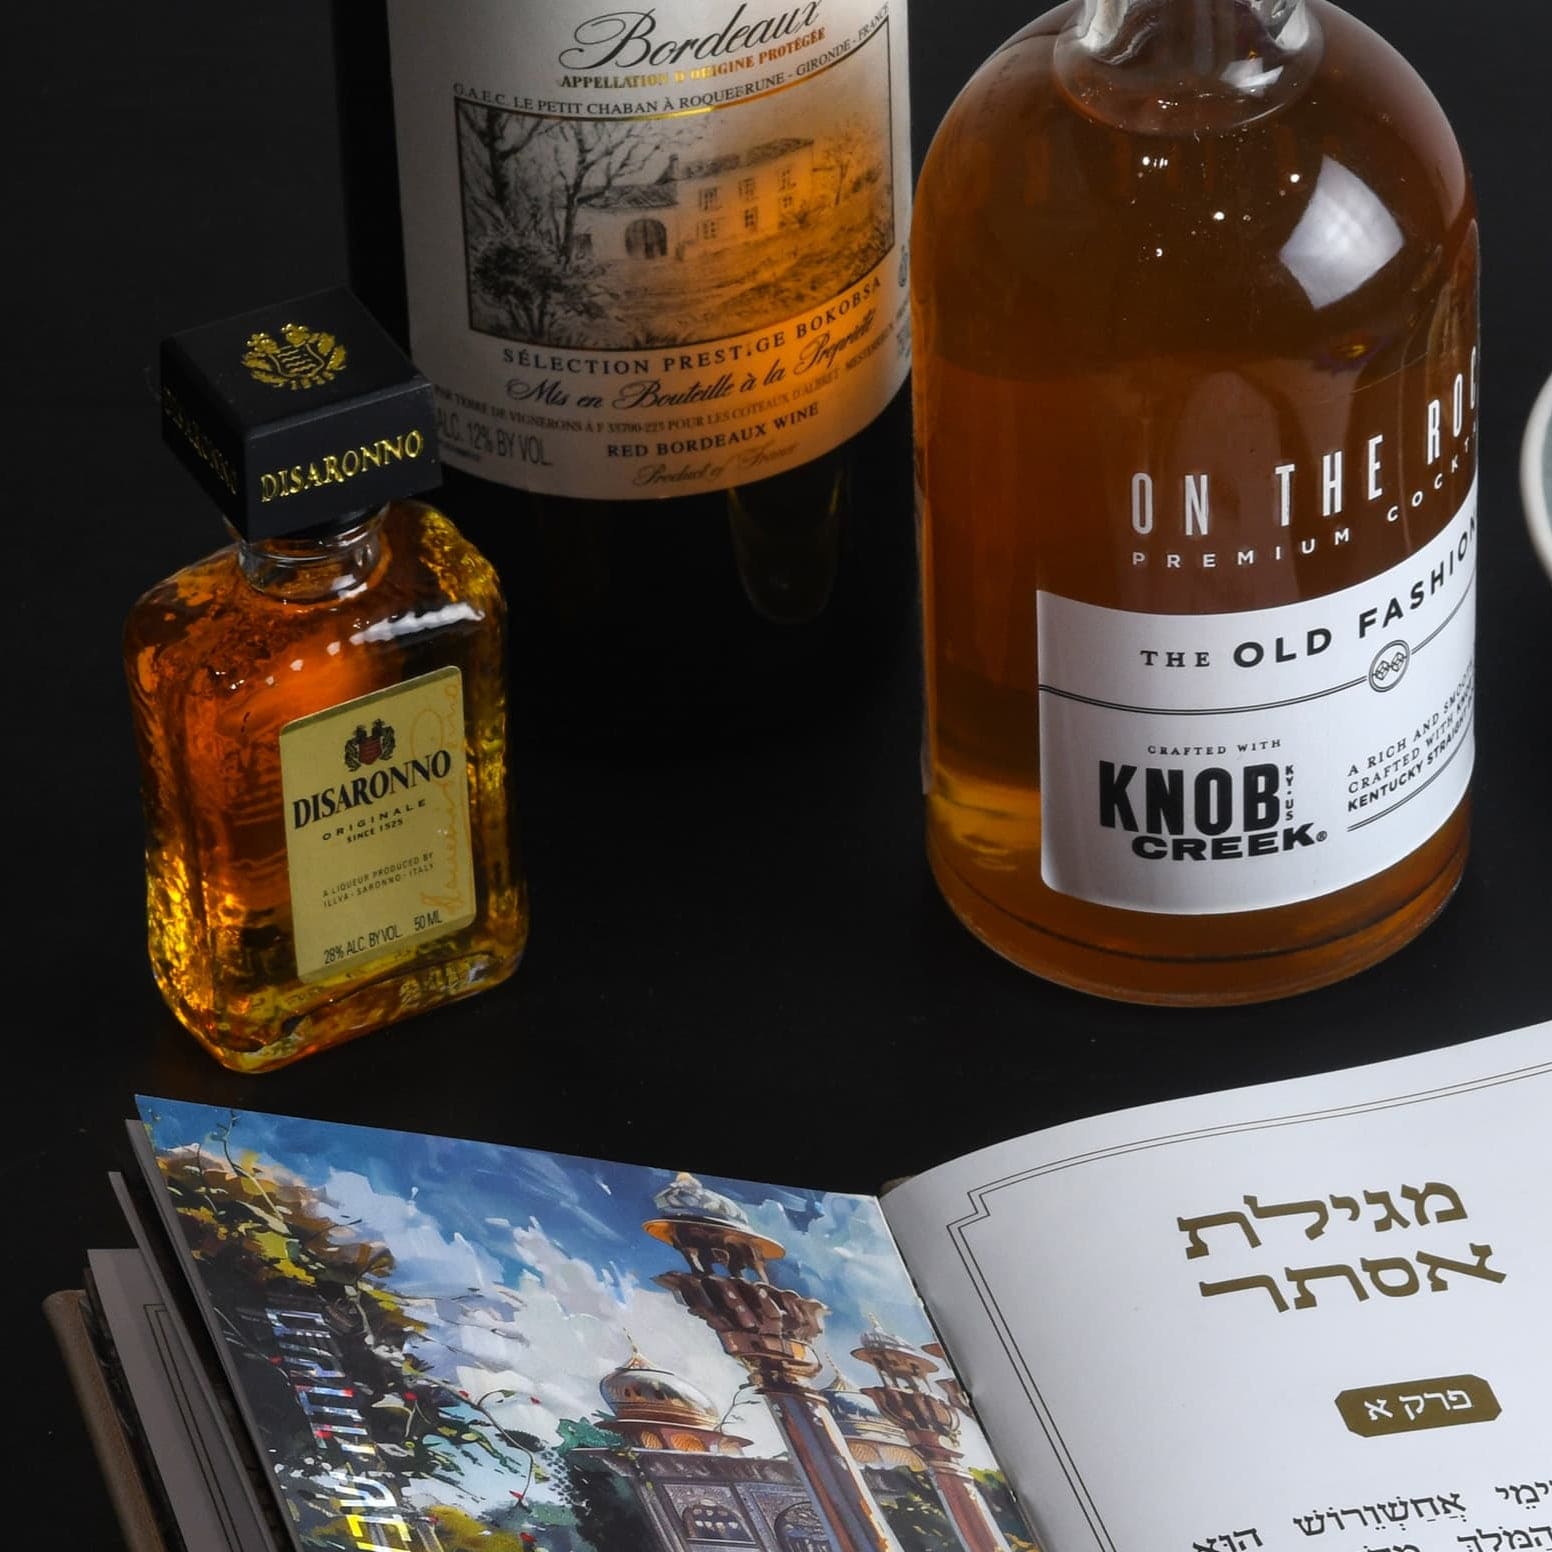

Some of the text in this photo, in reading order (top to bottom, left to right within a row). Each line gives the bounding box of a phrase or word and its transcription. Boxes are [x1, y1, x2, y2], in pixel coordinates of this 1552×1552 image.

[559, 0, 823, 70] Bordeaux
[514, 97, 533, 110] LE
[538, 100, 582, 114] PETIT
[586, 101, 659, 115] CHABAN
[679, 74, 786, 108] ROQUEBRUNE
[796, 41, 853, 77] GIRONDE
[560, 72, 668, 89] APPELLATION
[503, 347, 650, 375] SÉLECTION
[796, 276, 881, 340] BOKOBSA
[506, 378, 568, 406] Mis
[576, 395, 603, 408] en
[612, 374, 735, 410] Bouteille
[740, 373, 756, 392] à
[763, 359, 786, 385] la
[497, 429, 516, 457] BY
[607, 444, 649, 458] RED
[656, 424, 768, 456] BORDEAUX
[774, 402, 820, 430] WINE
[260, 430, 424, 502] DISARONNO
[1131, 472, 1209, 536] ON
[1274, 434, 1384, 527] THE
[1132, 527, 1351, 568] PREMIUM
[1140, 650, 1211, 668] THE
[1233, 628, 1332, 669] OLD
[1147, 739, 1281, 756] CRAFTED WITH
[1347, 764, 1359, 777] A
[1367, 738, 1407, 769] RICH
[1413, 712, 1439, 743] AND
[1348, 713, 1454, 794] CRAFTED WITH
[292, 750, 452, 830] DISARONNO
[1099, 760, 1281, 837] KNOB
[1347, 761, 1424, 812] KENTUCKY
[322, 799, 427, 841] ORIGINALE
[347, 819, 404, 843] SINCE 1525
[323, 863, 434, 908] ILLVA SARONNO ITALY
[332, 875, 369, 895] LIQUEUR
[372, 856, 420, 878] PRODUCED
[422, 852, 434, 862] BY
[324, 944, 344, 965] 28%
[414, 914, 426, 931] 50
[426, 910, 443, 925] ML
[1176, 1181, 1468, 1259] מגילת
[1199, 1243, 1506, 1312] אסתר
[1364, 1388, 1473, 1423] פרק א
